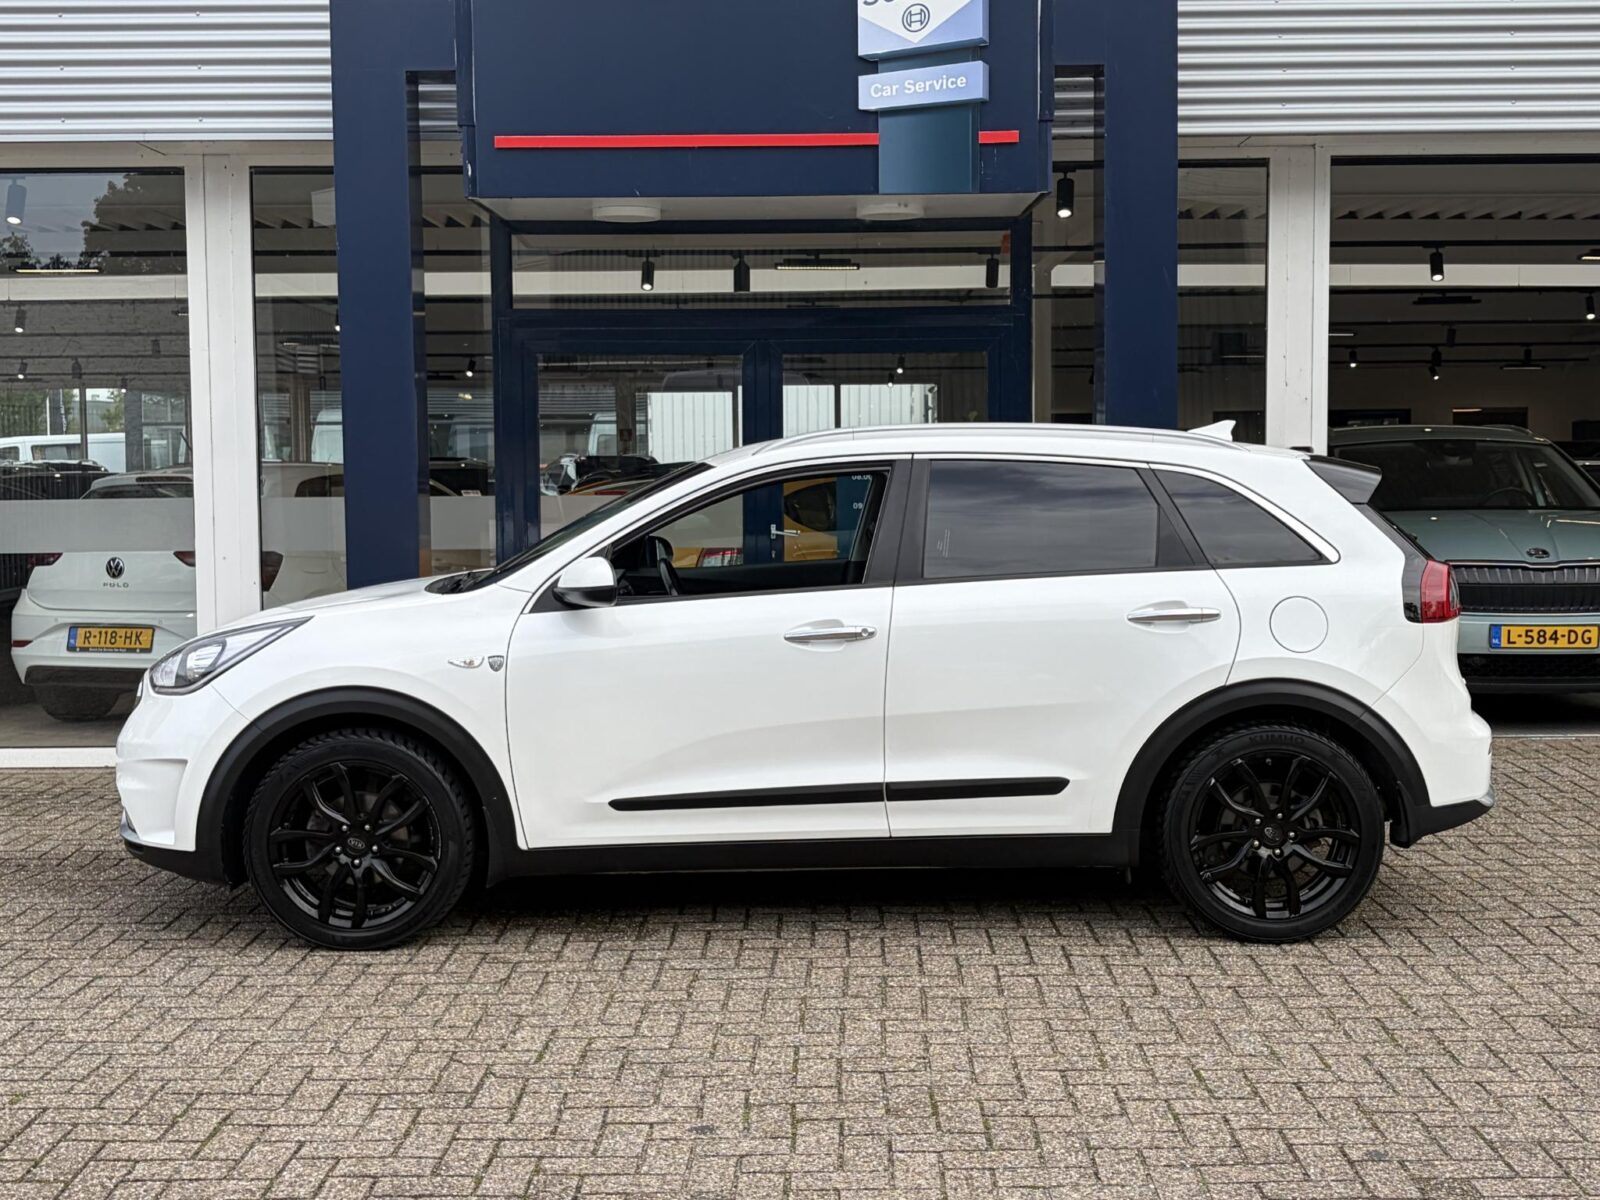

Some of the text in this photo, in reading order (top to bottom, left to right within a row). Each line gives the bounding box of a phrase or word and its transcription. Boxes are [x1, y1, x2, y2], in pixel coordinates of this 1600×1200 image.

[870, 75, 967, 98] Car Service
[83, 630, 143, 646] R-118-HK
[1507, 629, 1592, 645] L-584-DG
[1248, 733, 1305, 745] KUMHO
